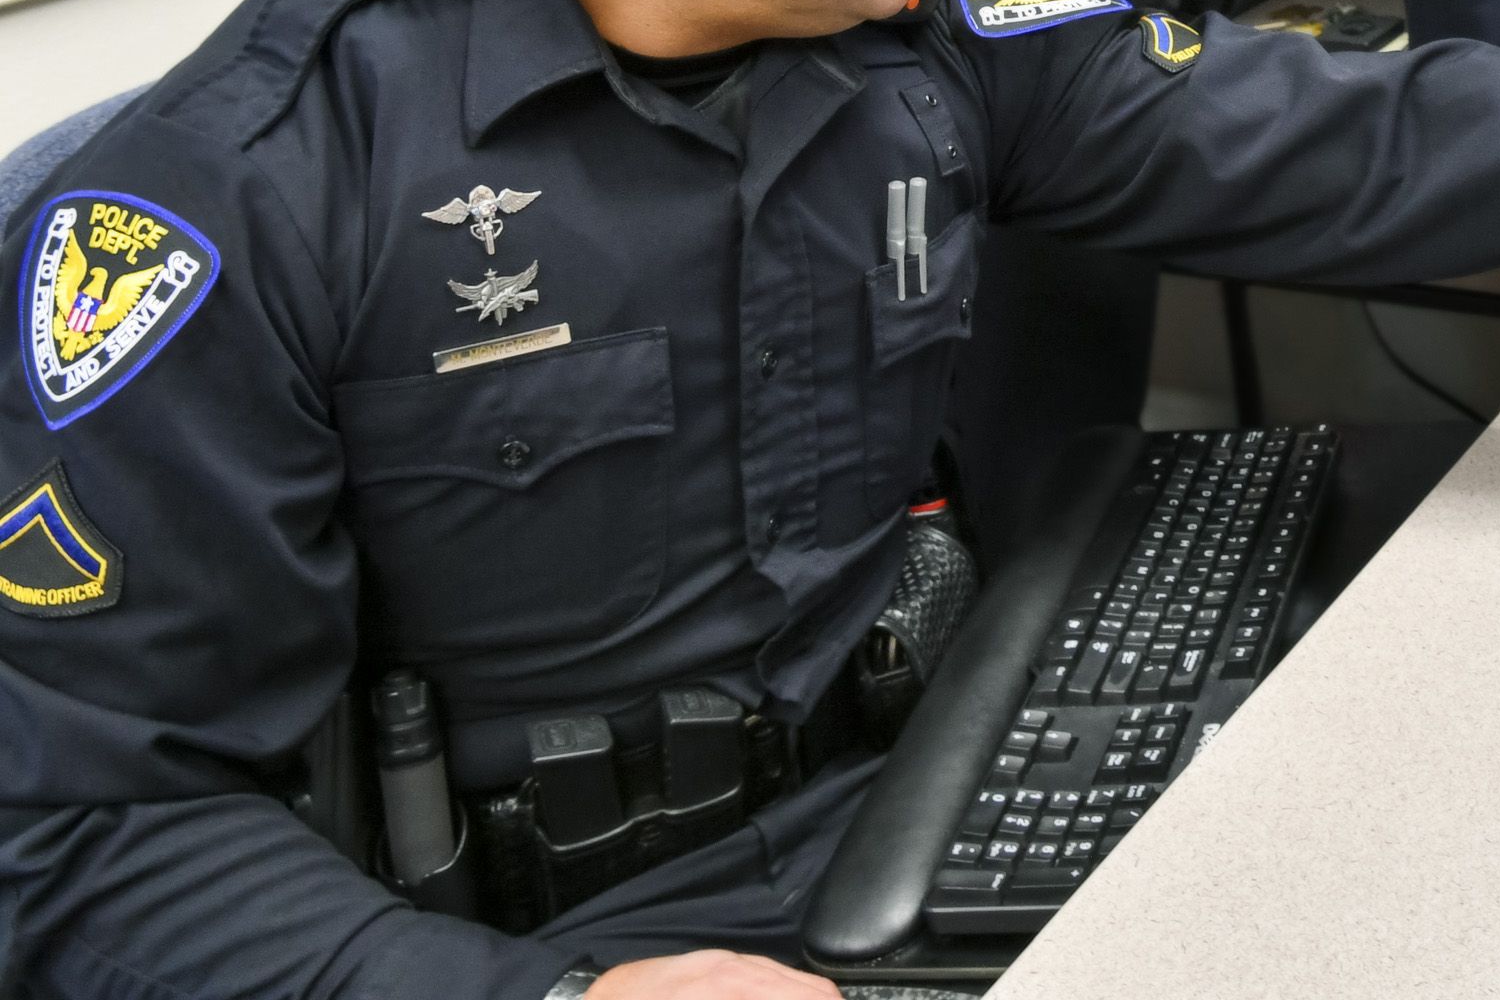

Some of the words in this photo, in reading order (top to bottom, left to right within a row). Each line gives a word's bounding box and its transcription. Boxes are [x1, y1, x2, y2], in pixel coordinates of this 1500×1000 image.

[89, 203, 169, 250] POLICE
[40, 249, 60, 280] TO
[35, 285, 58, 381] PROTECT
[105, 294, 166, 360] SERVE
[65, 358, 101, 392] AND
[47, 581, 104, 605] OFFICER
[992, 793, 1006, 802] 0
[1102, 789, 1115, 798] 7
[1016, 817, 1030, 827] 2
[1053, 818, 1068, 827] 5
[1003, 844, 1018, 853] 3
